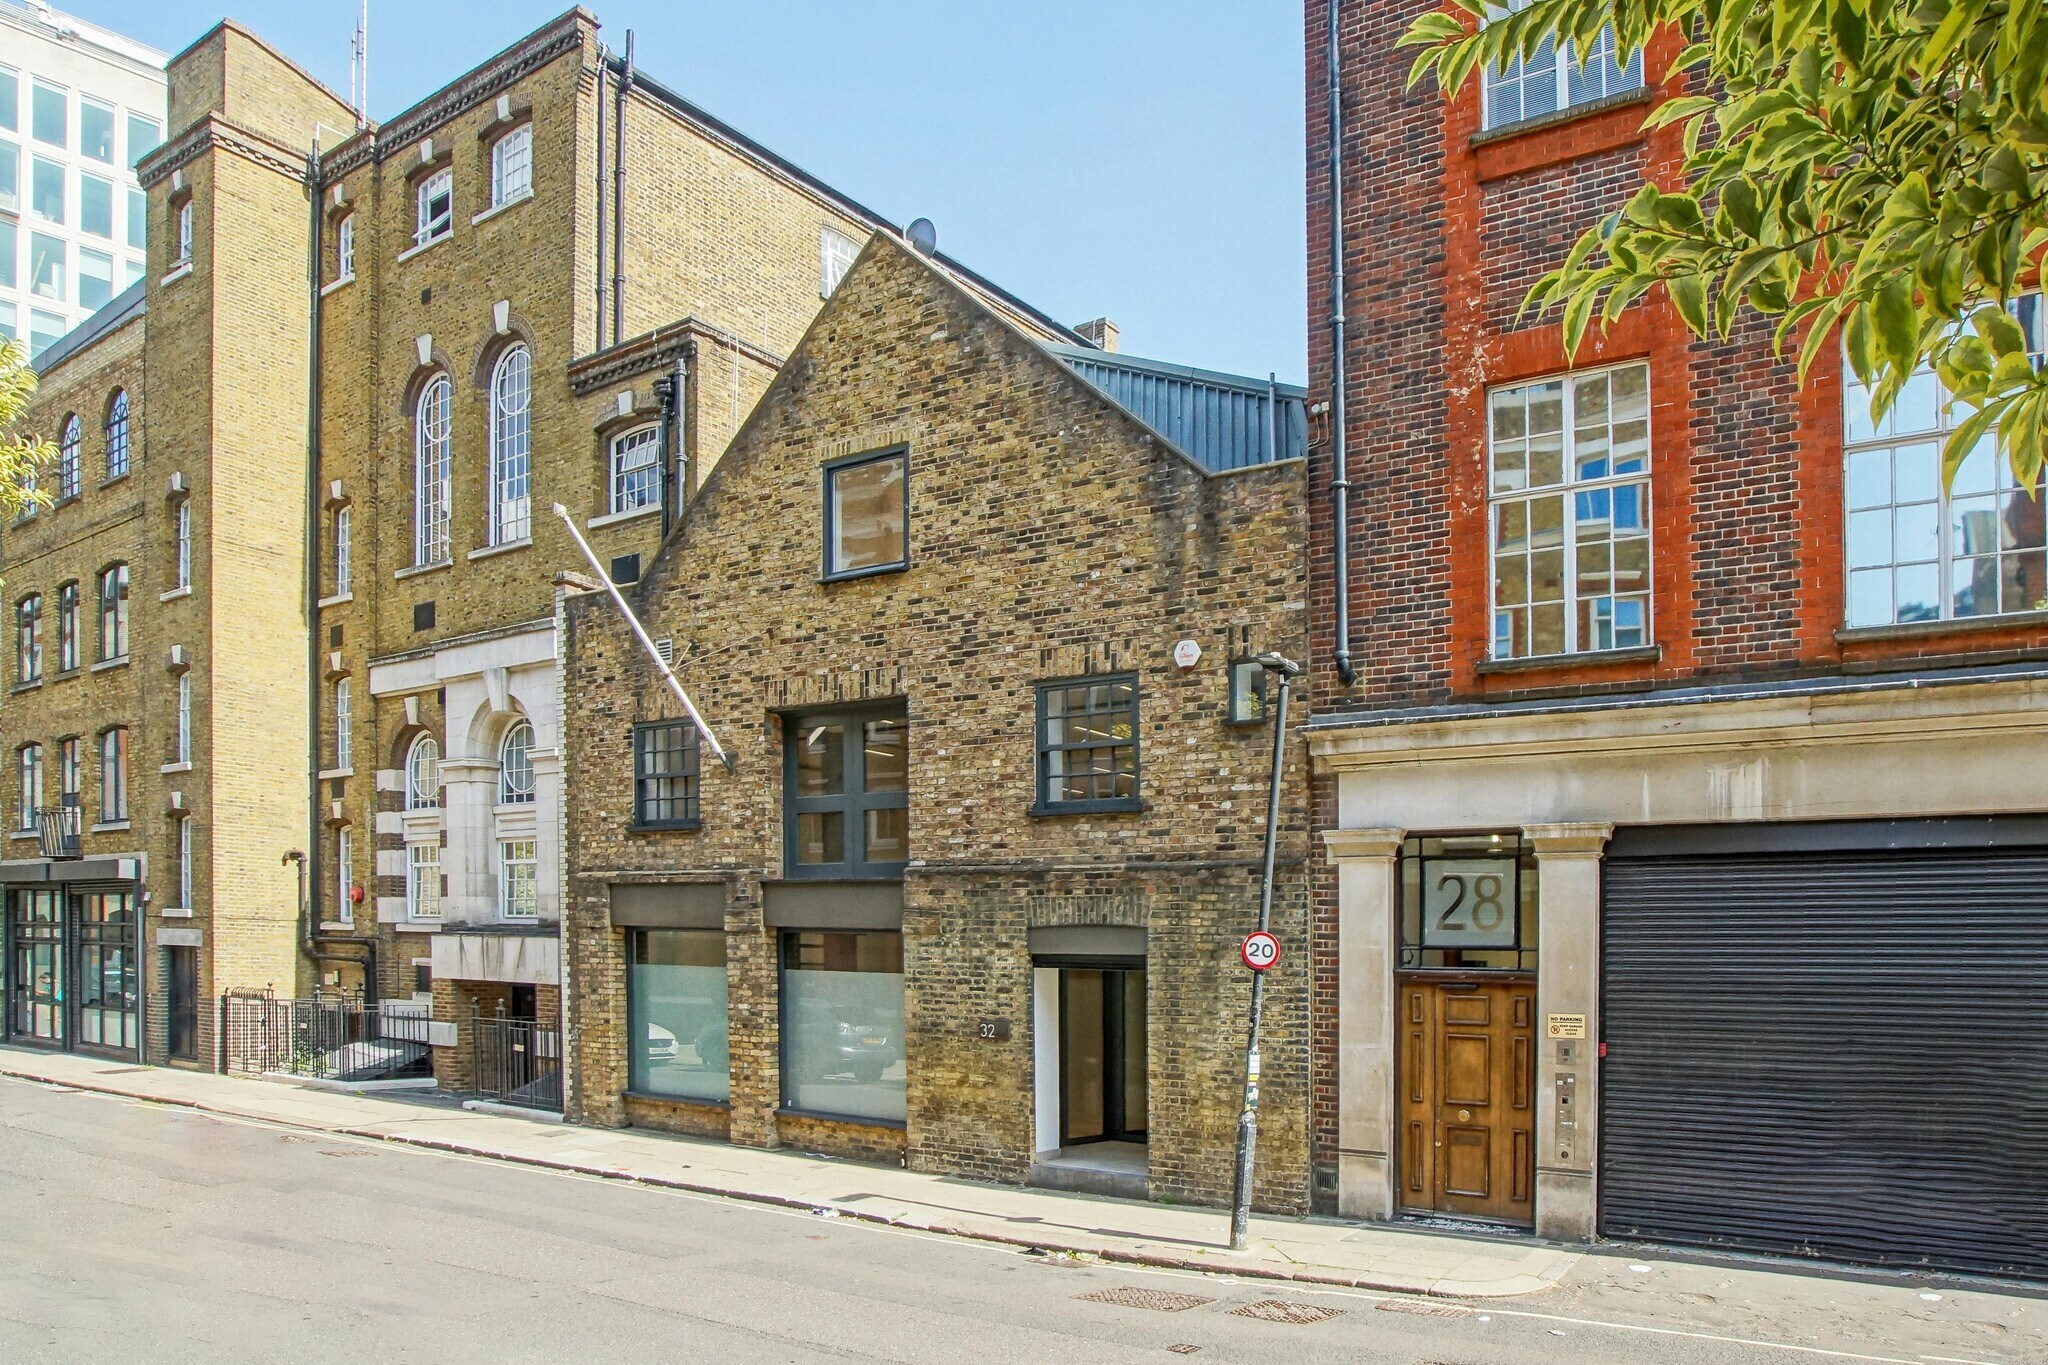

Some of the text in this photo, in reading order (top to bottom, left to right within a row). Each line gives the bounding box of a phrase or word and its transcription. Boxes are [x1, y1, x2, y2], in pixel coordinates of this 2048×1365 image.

[1436, 874, 1503, 931] 28
[1248, 942, 1274, 958] 20
[980, 1023, 995, 1038] 32
